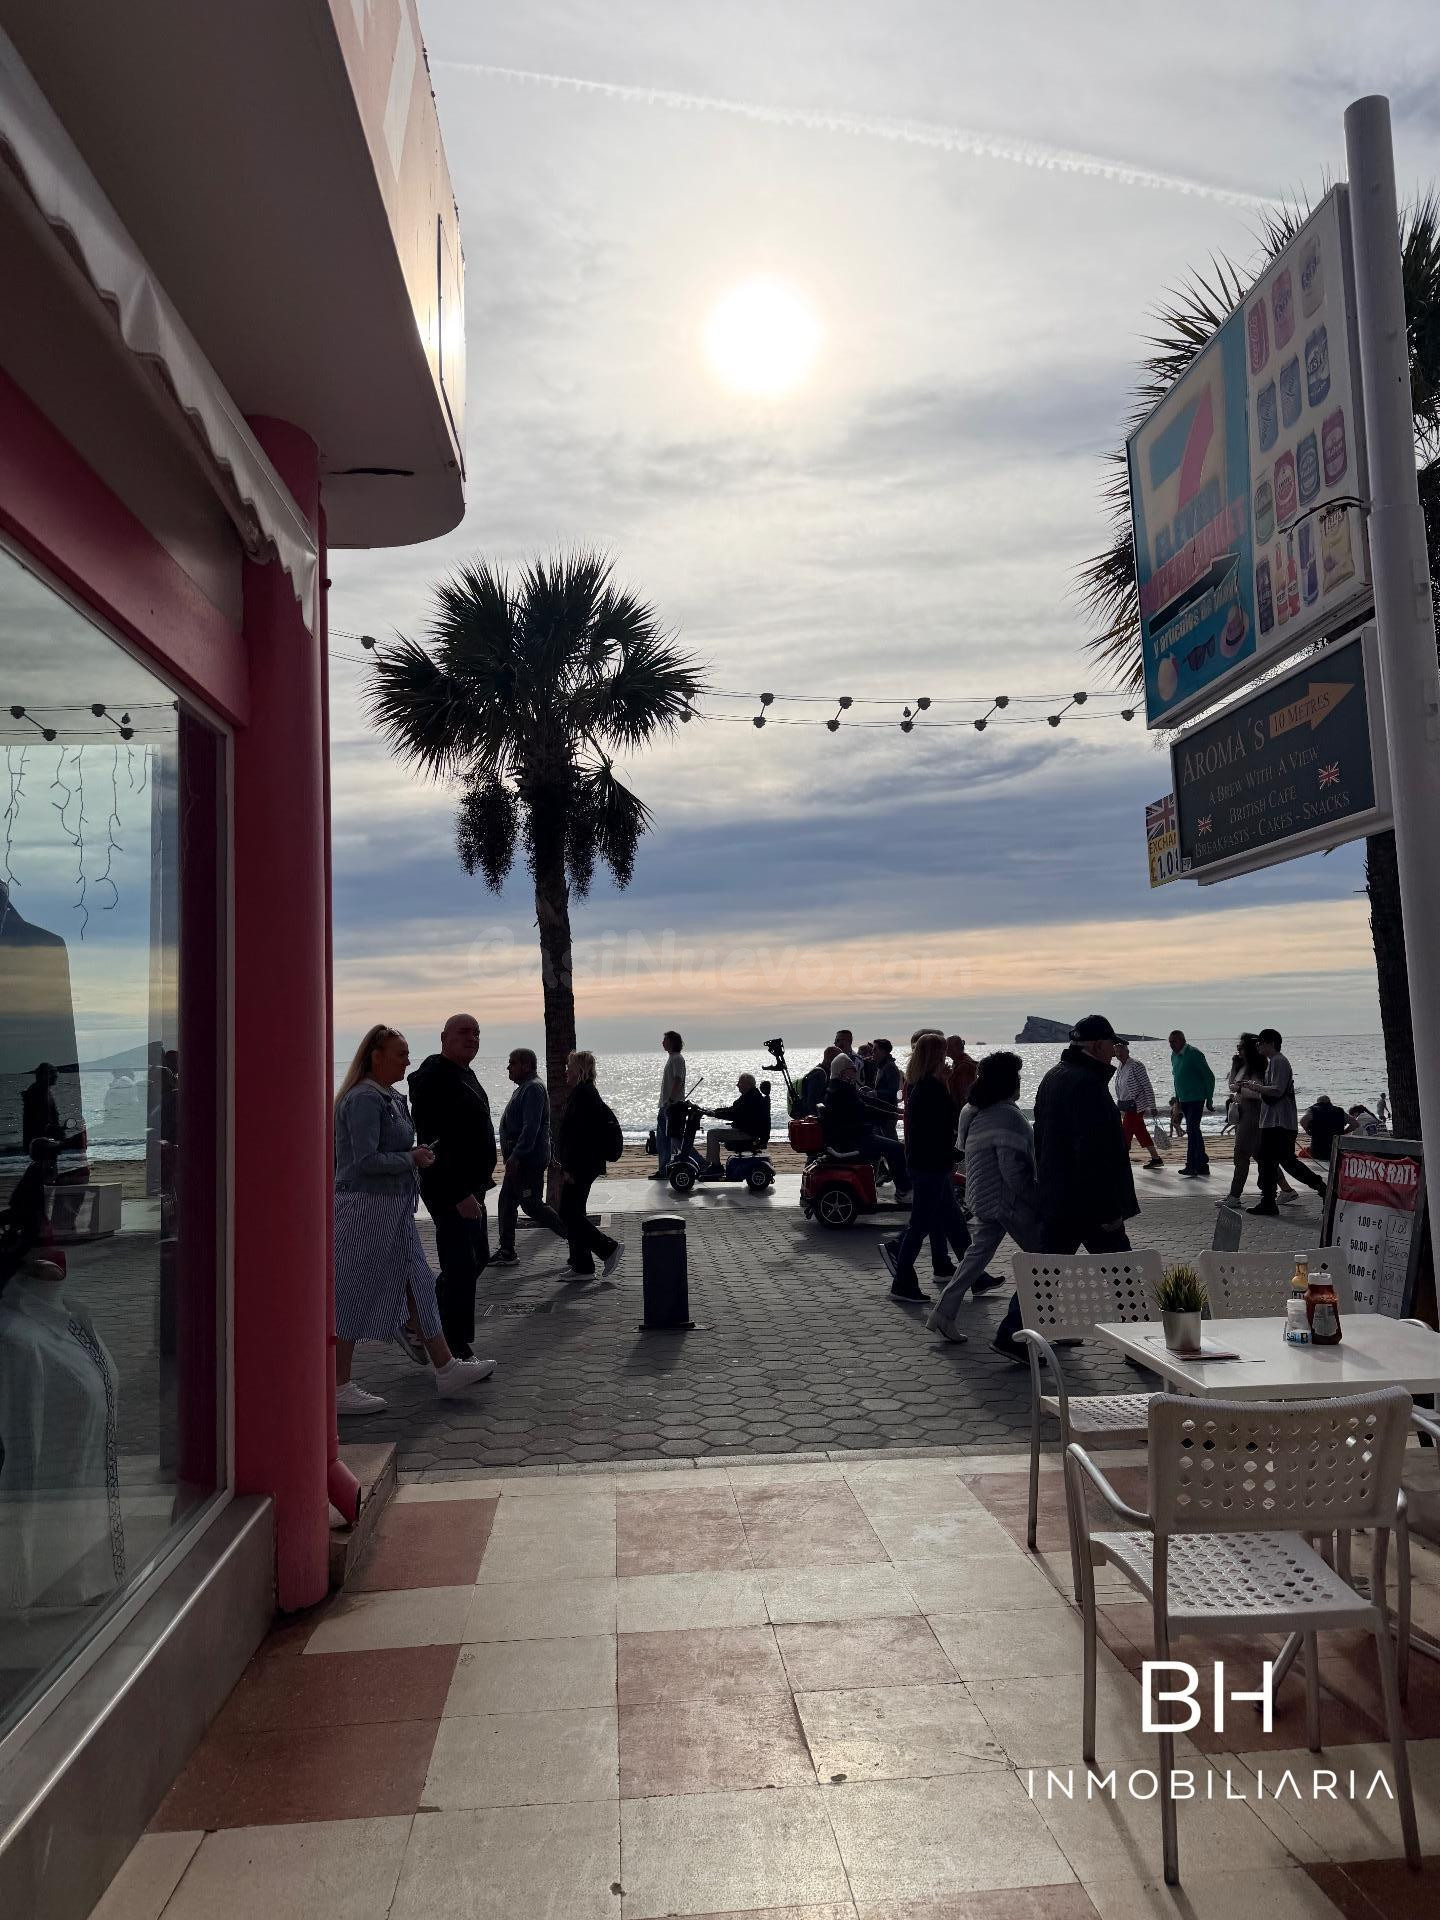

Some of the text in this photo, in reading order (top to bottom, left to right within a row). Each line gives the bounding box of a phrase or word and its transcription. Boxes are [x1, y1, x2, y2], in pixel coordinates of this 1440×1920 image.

[1274, 713, 1286, 732] 10
[1209, 790, 1217, 808] A
[1278, 756, 1287, 777] A
[1358, 1215, 1371, 1228] 1.00
[1350, 1238, 1368, 1252] 50.00
